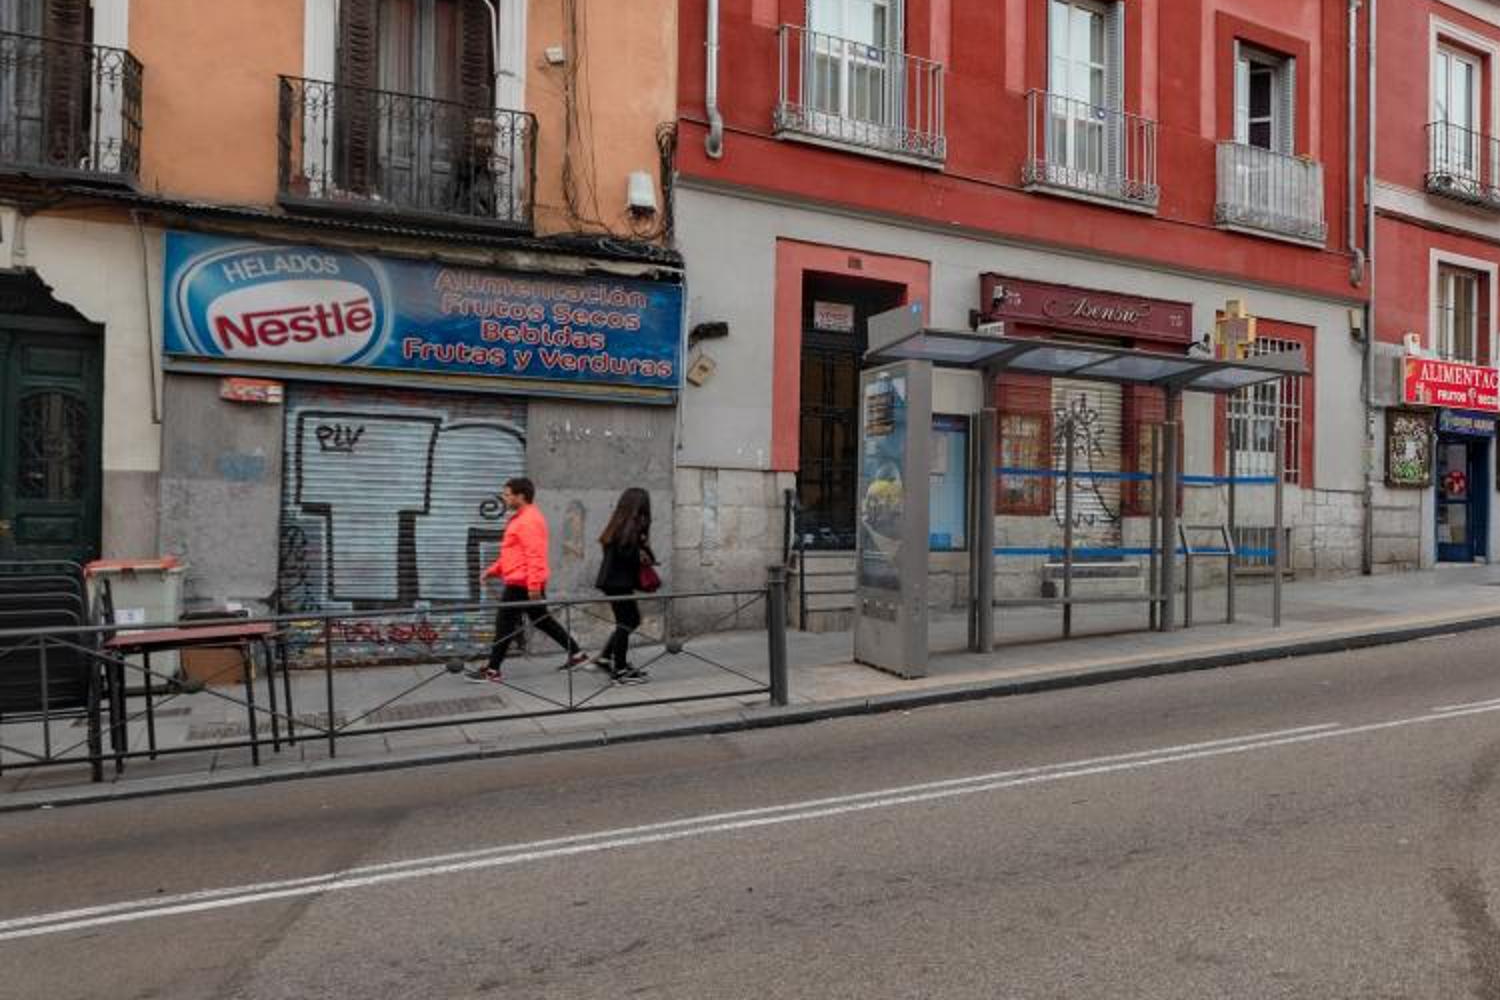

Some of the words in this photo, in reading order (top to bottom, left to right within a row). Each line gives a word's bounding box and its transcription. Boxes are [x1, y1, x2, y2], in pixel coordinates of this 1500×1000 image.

[222, 255, 340, 283] HELADOS
[434, 269, 648, 309] Alimentación
[214, 298, 374, 350] Nestlé
[442, 293, 545, 321] Frutos
[551, 303, 642, 330] Secos
[480, 319, 606, 349] Bebidas
[403, 336, 507, 366] Frutas
[514, 350, 533, 371] y
[539, 347, 674, 377] Verduras
[1420, 362, 1499, 389] ALIMENTAC
